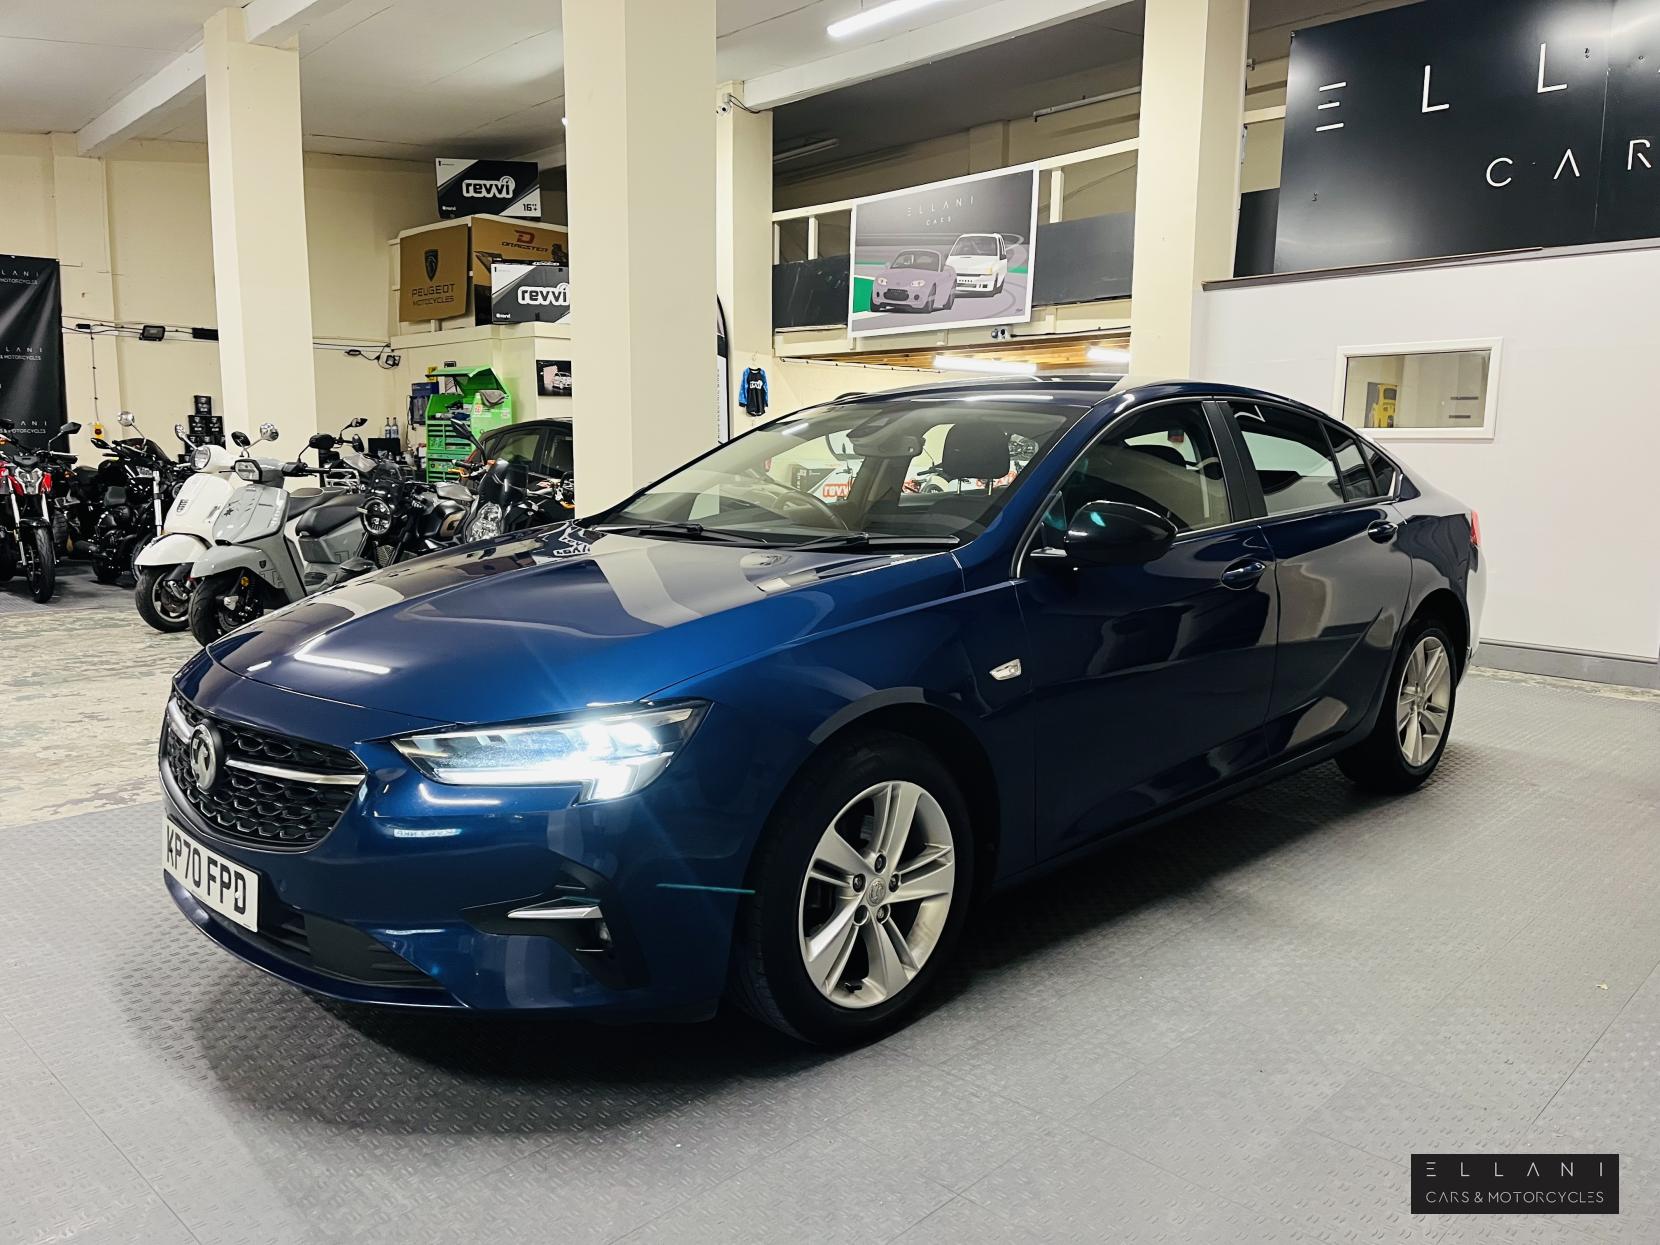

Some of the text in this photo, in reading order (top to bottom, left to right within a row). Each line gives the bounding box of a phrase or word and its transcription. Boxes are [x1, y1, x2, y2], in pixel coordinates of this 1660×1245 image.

[1316, 43, 1568, 132] ELL
[1486, 139, 1652, 188] CAR
[463, 177, 514, 197] revvi
[906, 196, 974, 217] ELLANI
[926, 216, 951, 226] CARS
[502, 241, 548, 252] DRAGSTER
[412, 283, 455, 298] PEUGEOT
[519, 284, 568, 305] revvi
[167, 825, 246, 915] KP70 FPD
